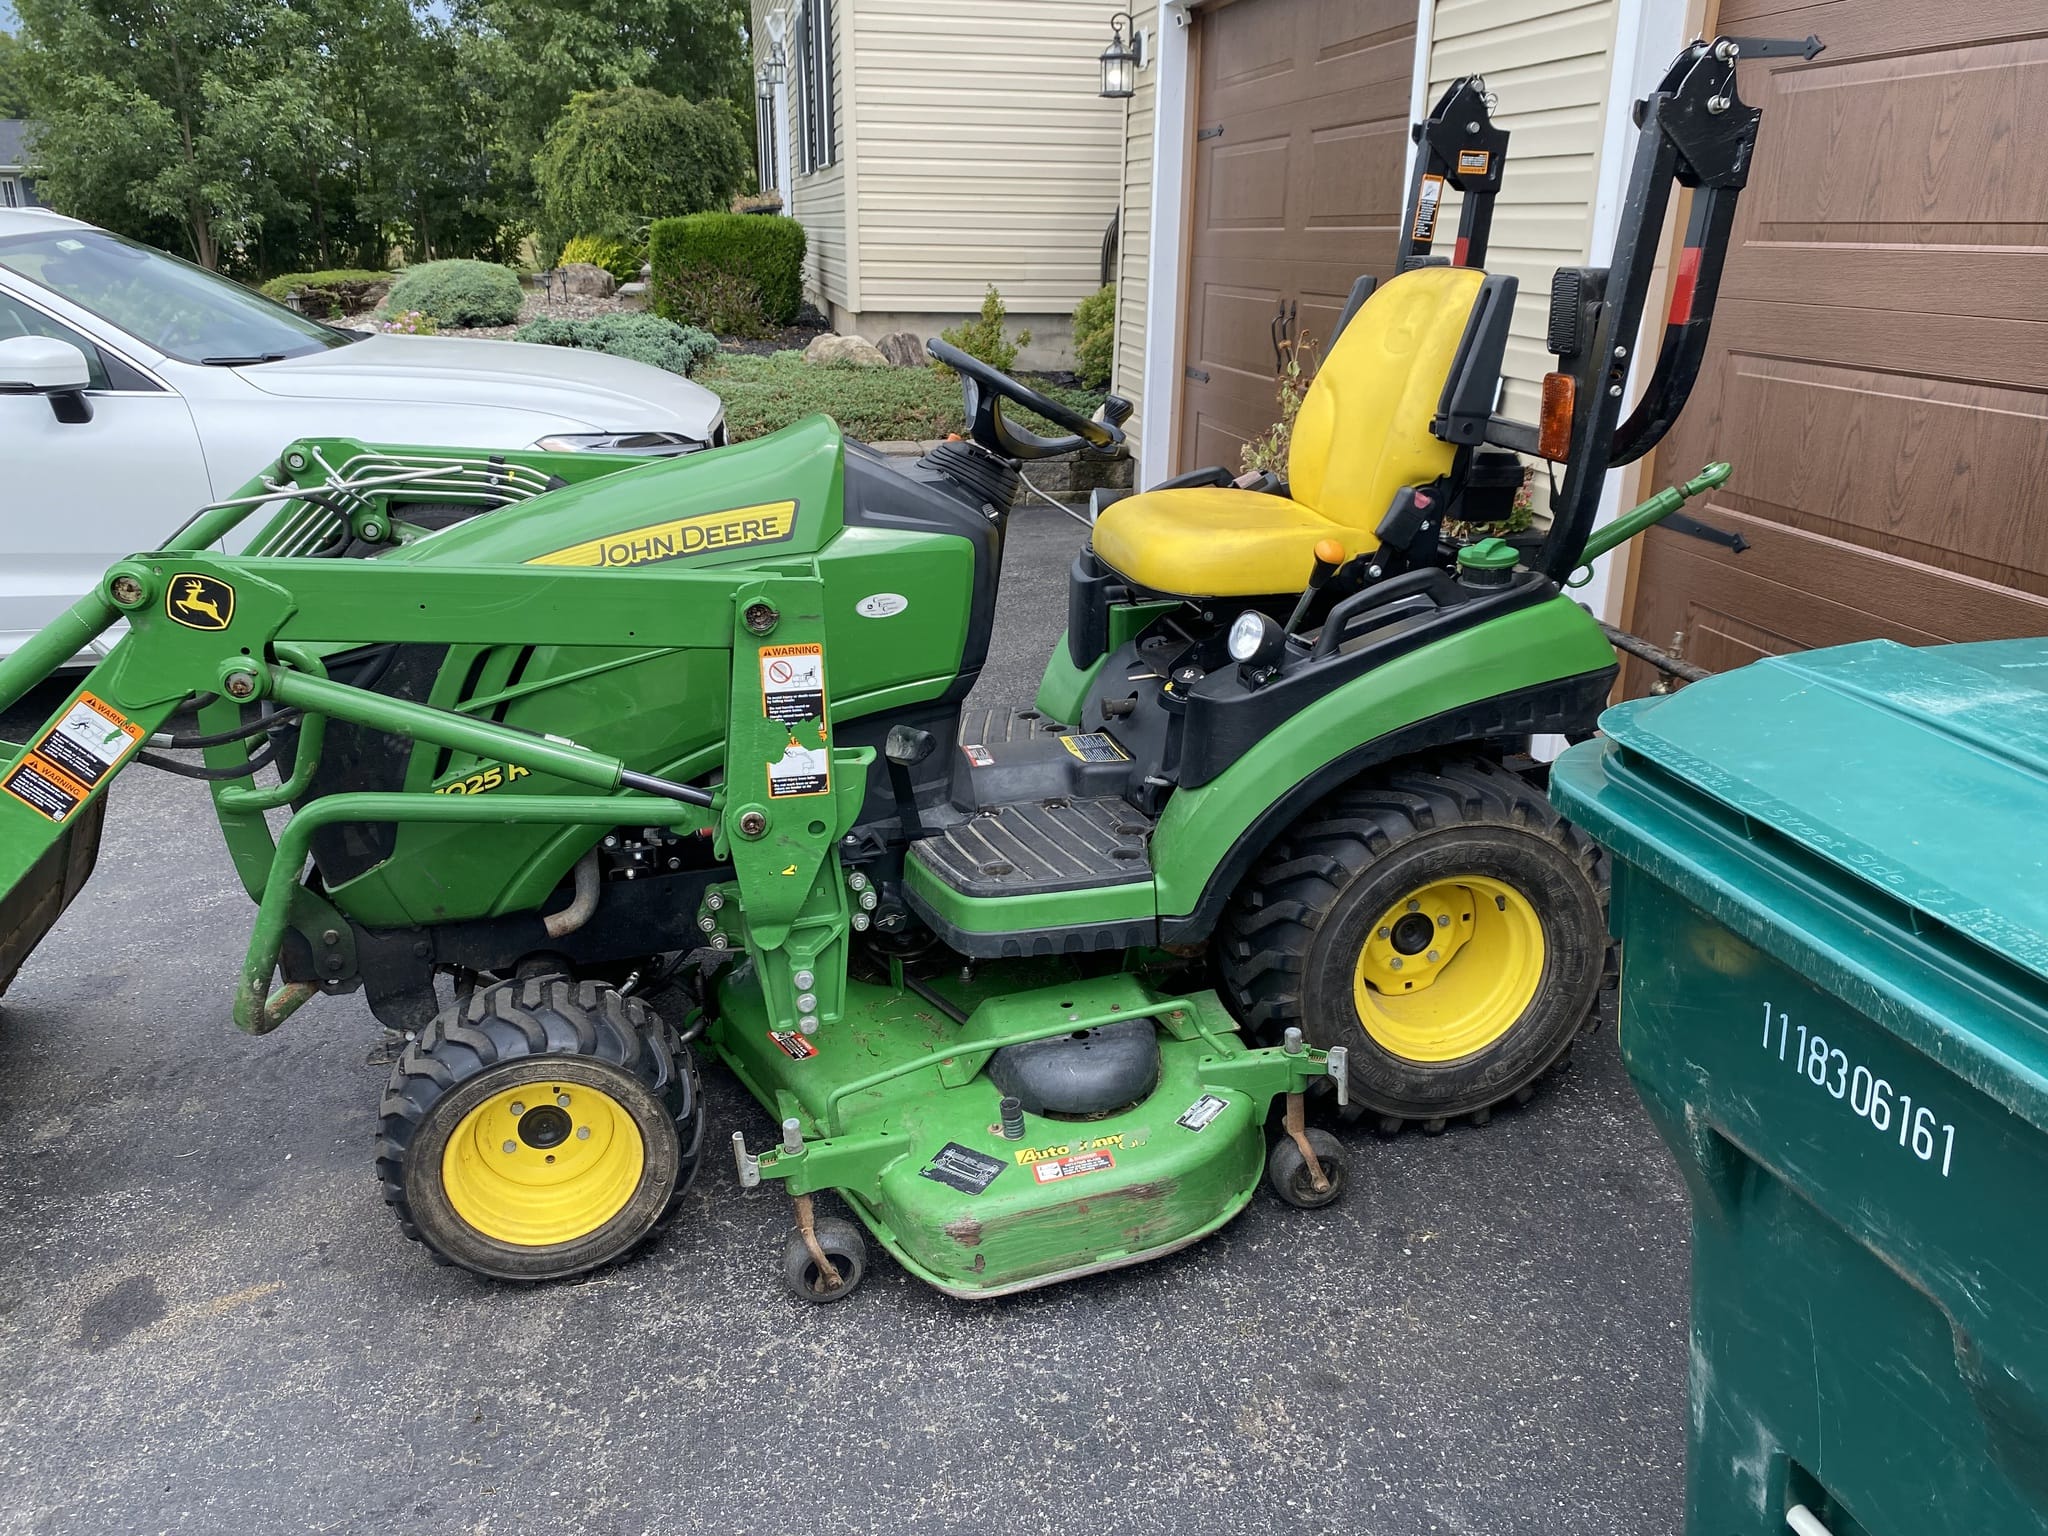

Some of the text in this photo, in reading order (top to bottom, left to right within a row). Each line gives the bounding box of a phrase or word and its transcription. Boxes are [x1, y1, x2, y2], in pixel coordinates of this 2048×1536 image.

[596, 516, 780, 567] JOHN DEERE
[772, 646, 819, 656] WARNING
[97, 703, 136, 734] WARNING
[41, 767, 80, 796] WARNING
[433, 766, 503, 795] 025
[1766, 807, 1905, 885] Street Side
[1763, 1001, 1955, 1177] 1118306161
